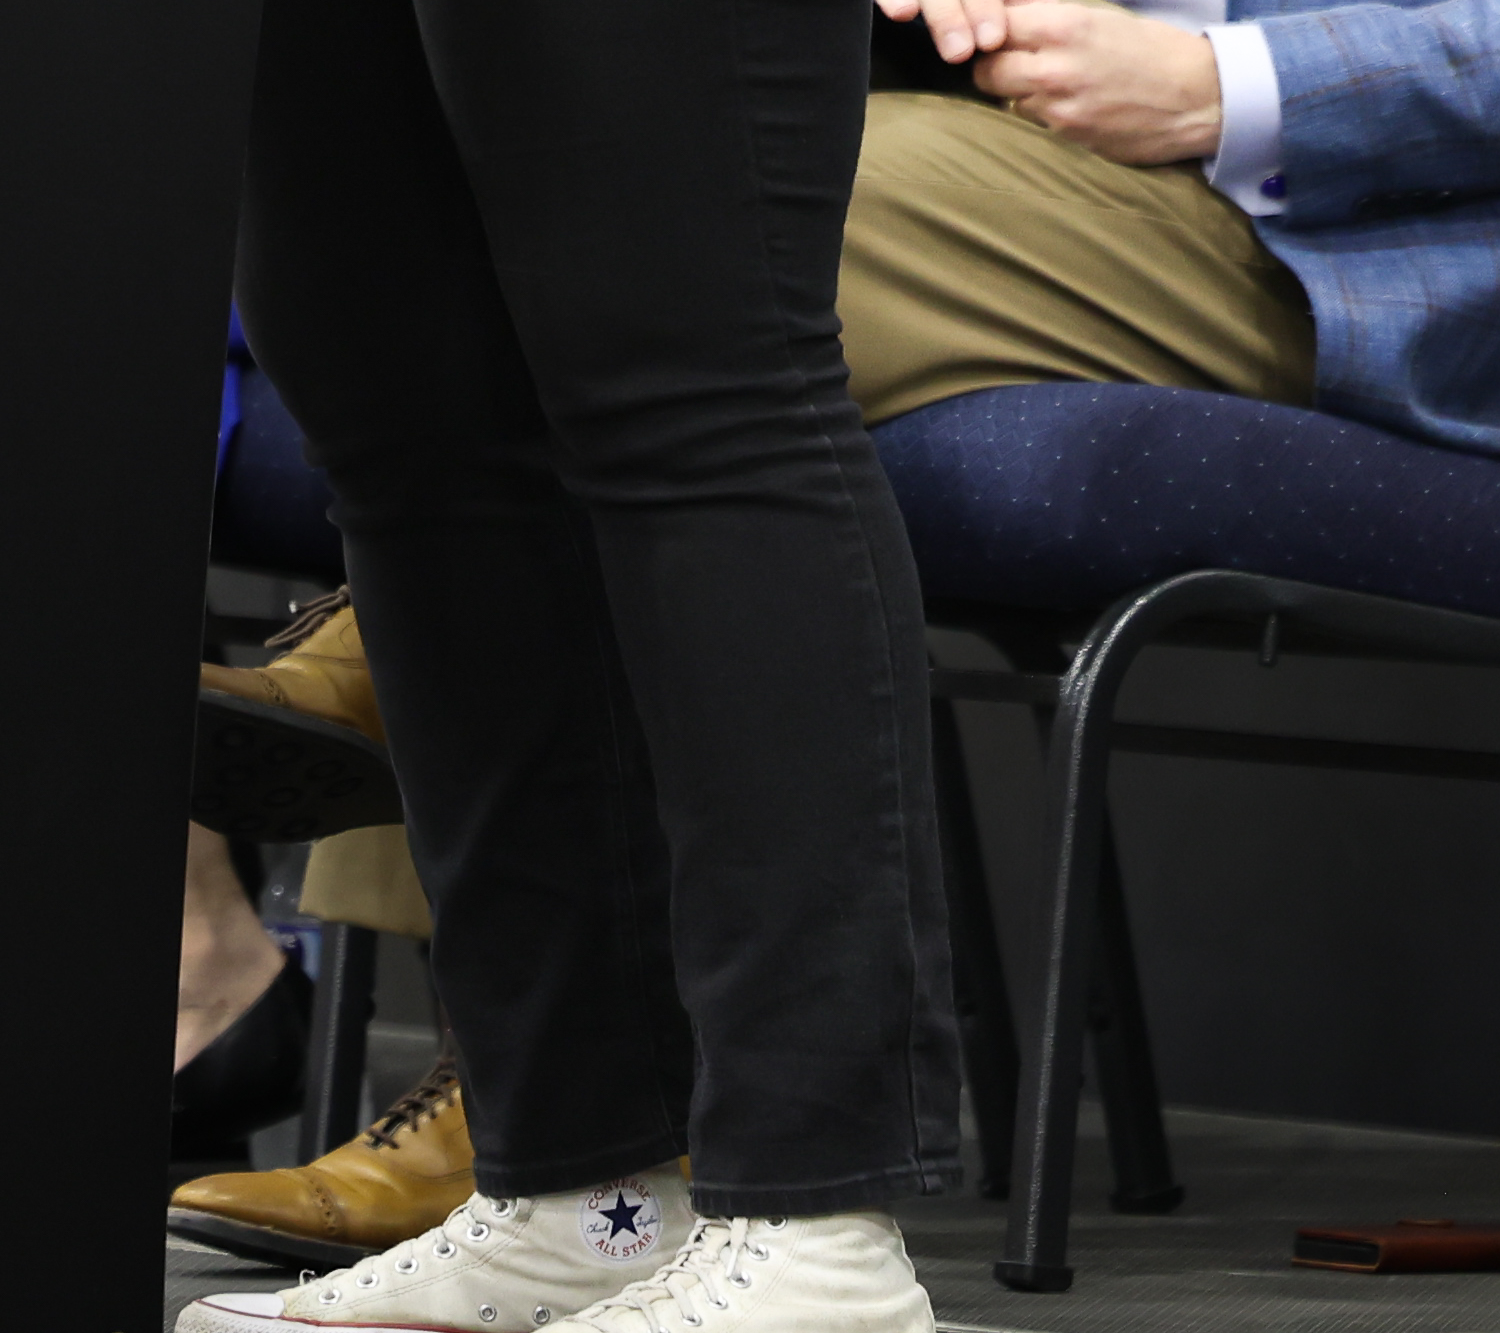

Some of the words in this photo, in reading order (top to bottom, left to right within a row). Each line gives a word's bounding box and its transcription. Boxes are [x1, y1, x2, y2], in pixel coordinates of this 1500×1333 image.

[588, 1177, 651, 1210] CONVERSE
[595, 1238, 617, 1257] ALL
[622, 1231, 653, 1257] STAR
